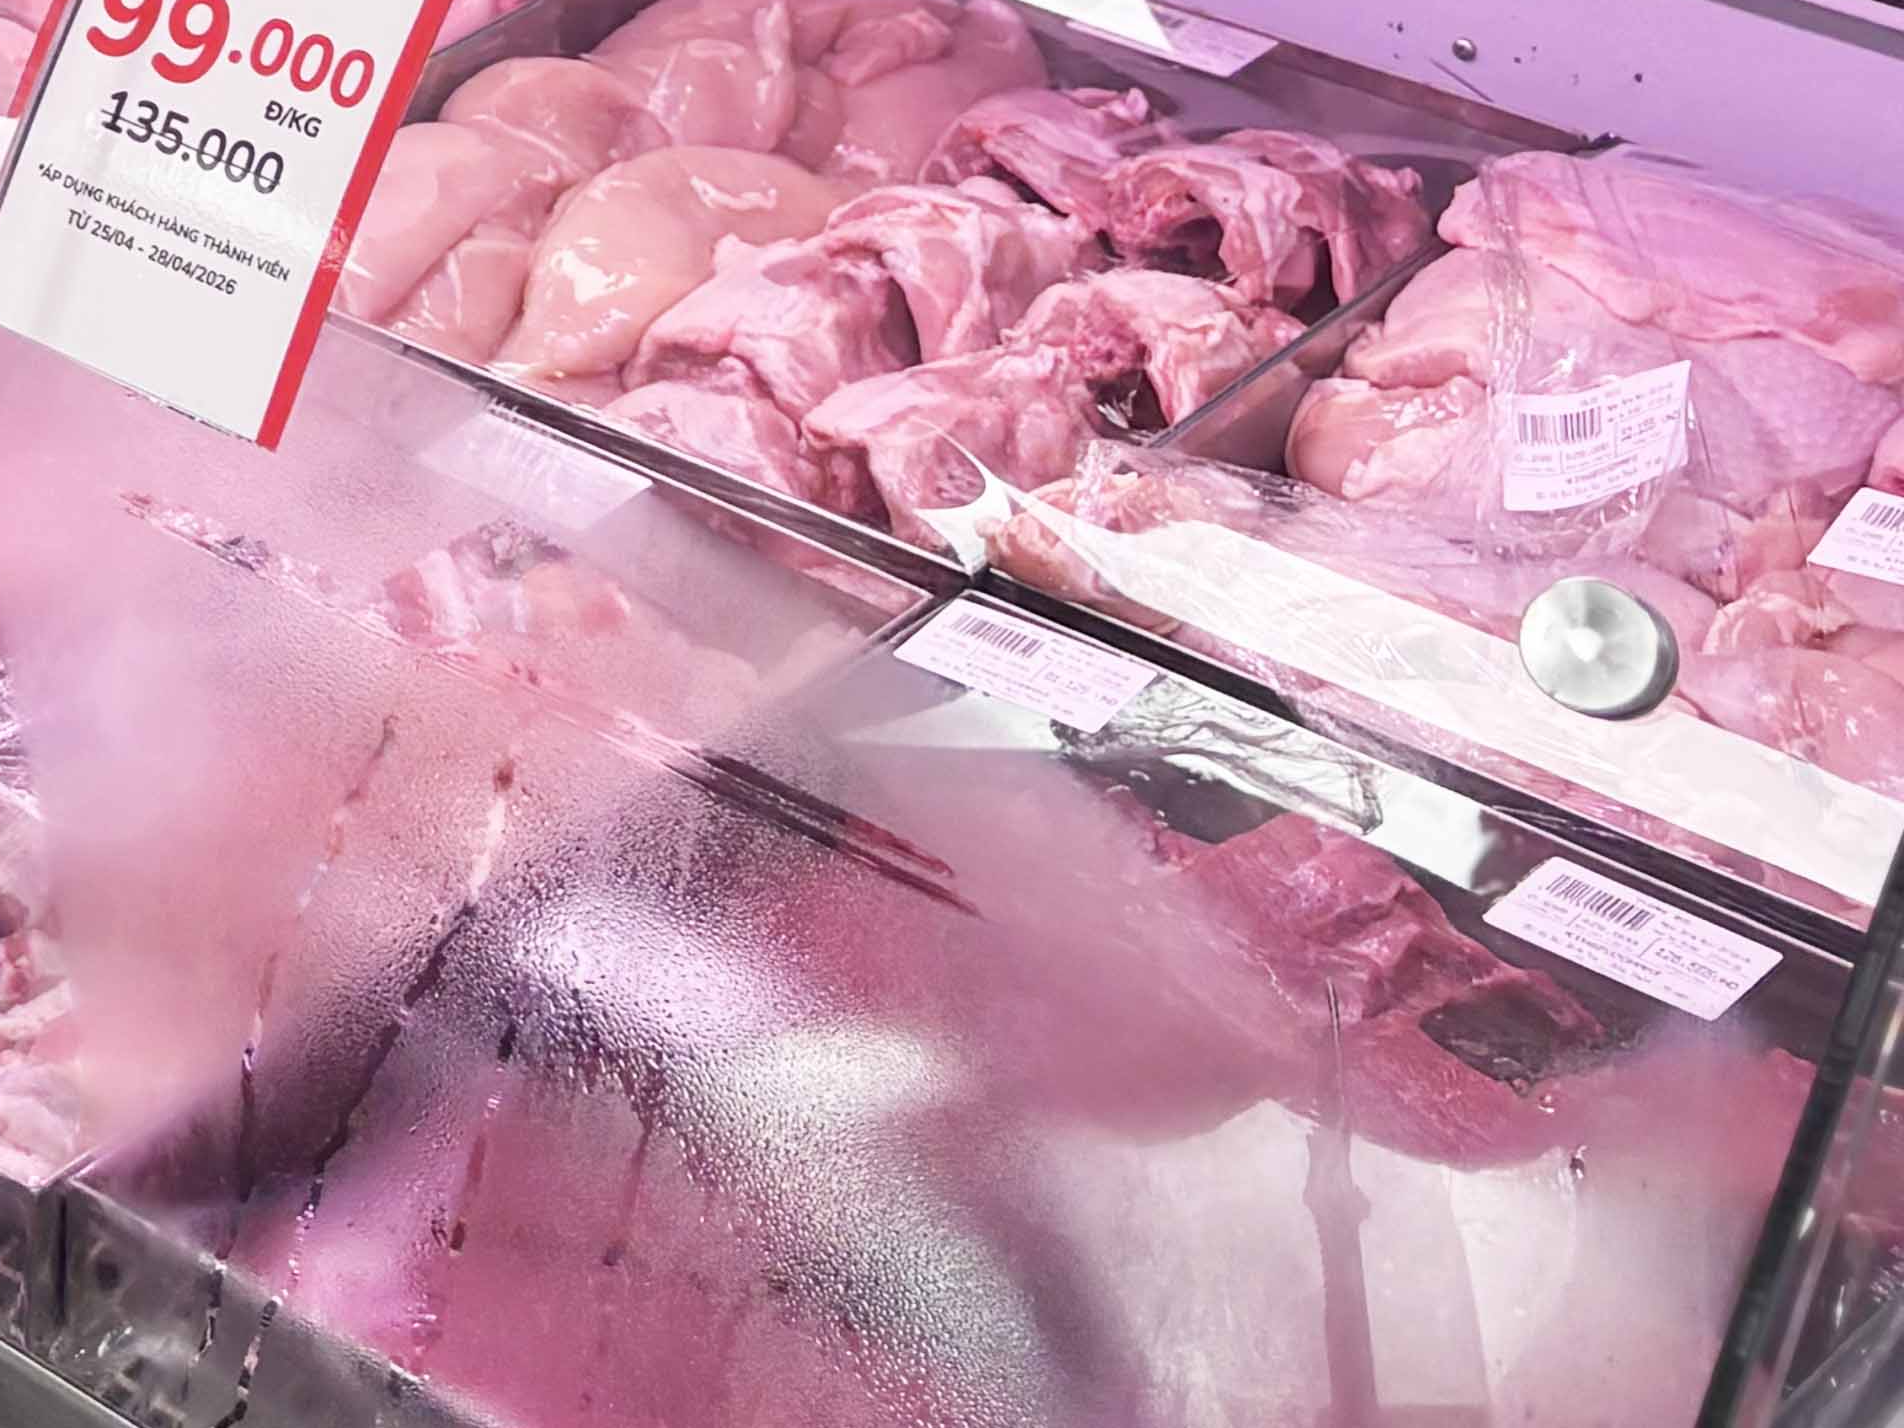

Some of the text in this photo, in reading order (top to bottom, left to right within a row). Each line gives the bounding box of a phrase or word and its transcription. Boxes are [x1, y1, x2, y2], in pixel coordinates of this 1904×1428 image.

[101, 91, 284, 194] 135.000
[264, 99, 322, 138] Đ/KG
[63, 176, 103, 204] DỤNG
[106, 193, 156, 225] KHÁCH
[159, 213, 199, 244] HÀNG
[203, 232, 253, 266] THÀNH
[256, 254, 290, 282] VIÊN
[67, 206, 90, 231] TỪ
[91, 219, 135, 251] 25/04
[148, 245, 237, 295] 28/04/2026
